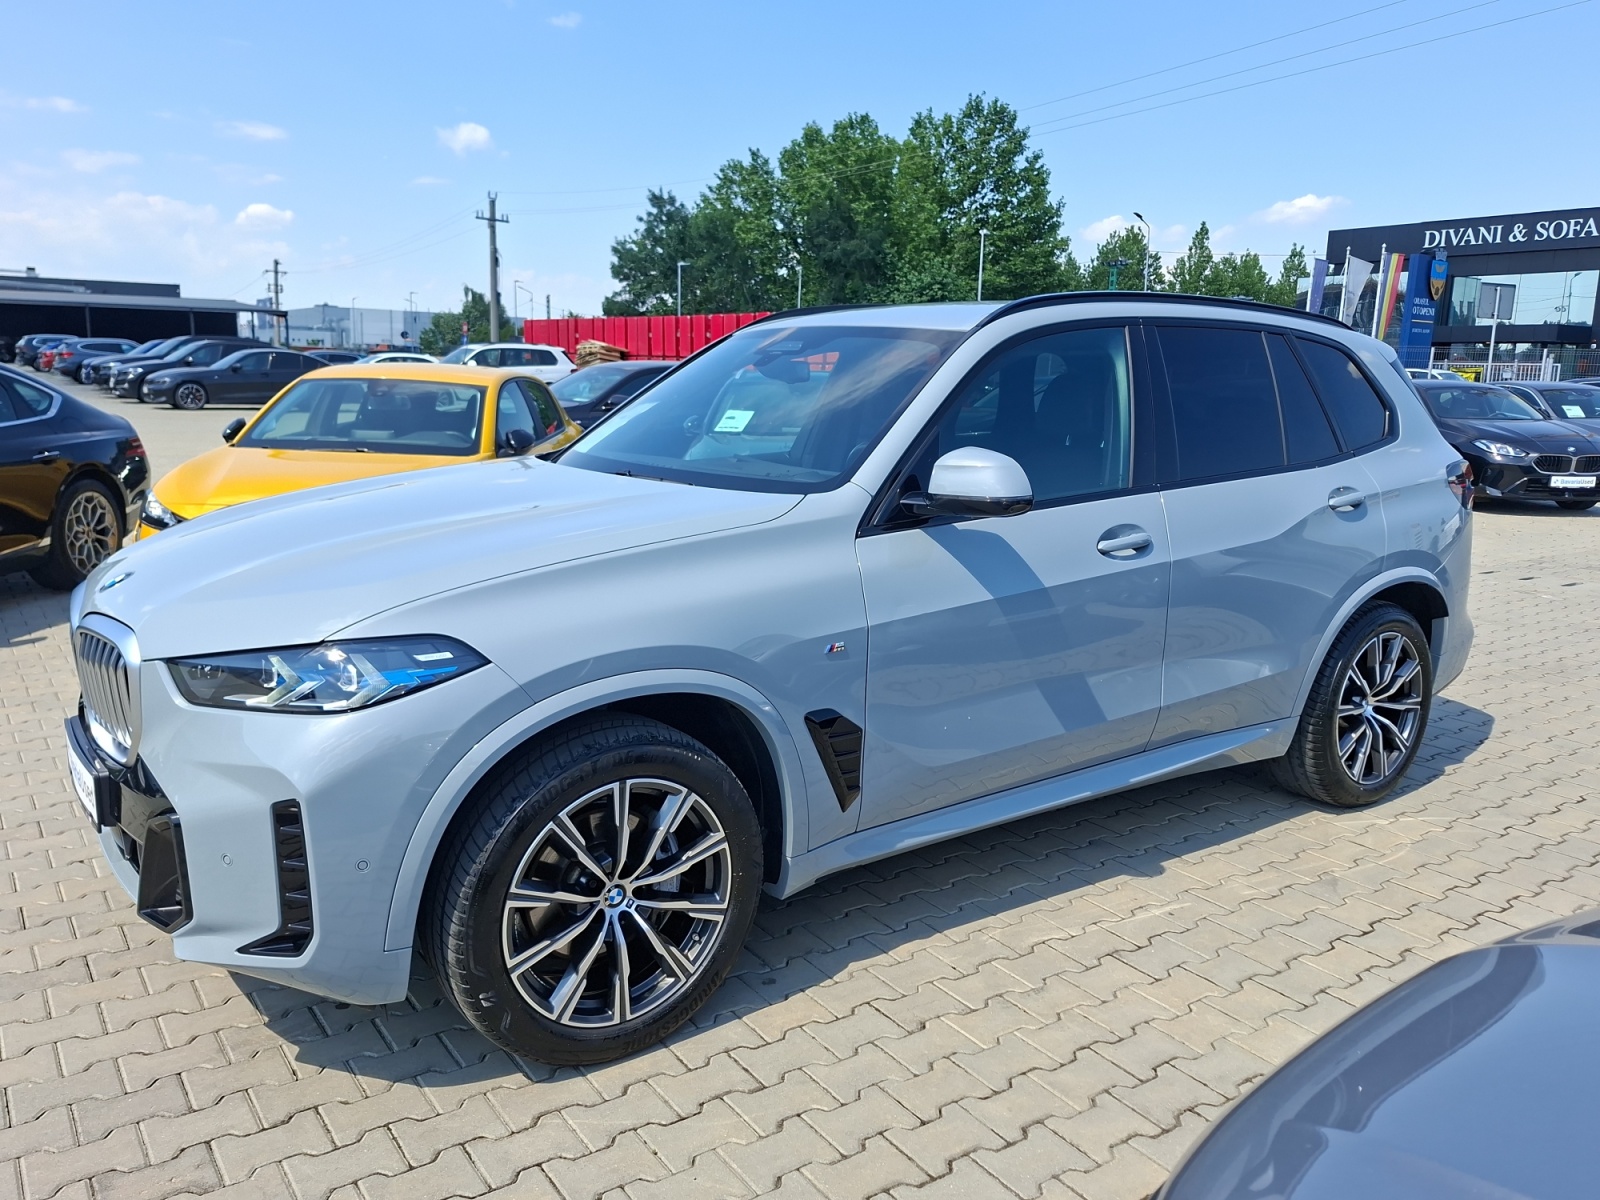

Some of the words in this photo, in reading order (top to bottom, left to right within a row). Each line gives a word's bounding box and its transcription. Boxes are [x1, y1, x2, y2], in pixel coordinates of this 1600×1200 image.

[1423, 225, 1504, 248] DIVANI
[1508, 223, 1528, 242] &
[1412, 306, 1435, 316] OTOPENI
